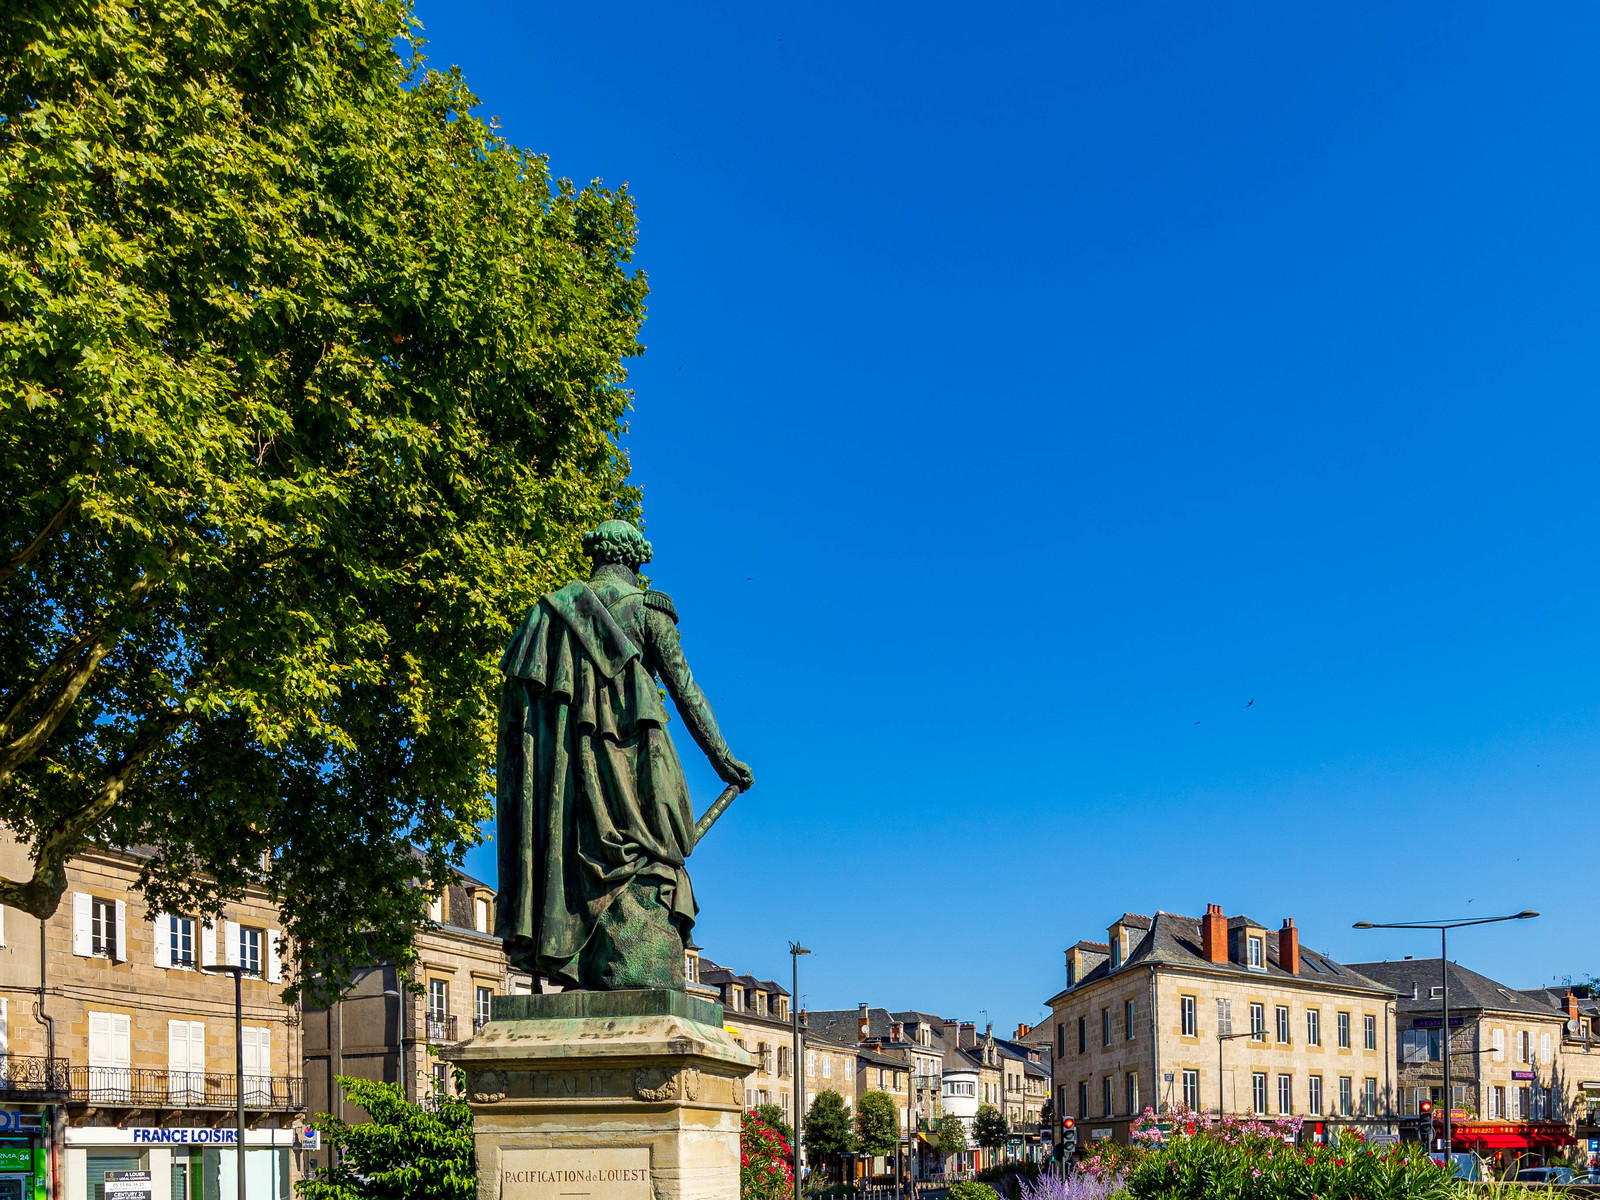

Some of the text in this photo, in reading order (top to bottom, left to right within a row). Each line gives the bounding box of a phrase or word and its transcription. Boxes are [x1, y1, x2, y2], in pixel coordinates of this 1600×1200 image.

[133, 1129, 188, 1143] FRANCE
[505, 1168, 647, 1184] PACIFICATION de L'OUEST
